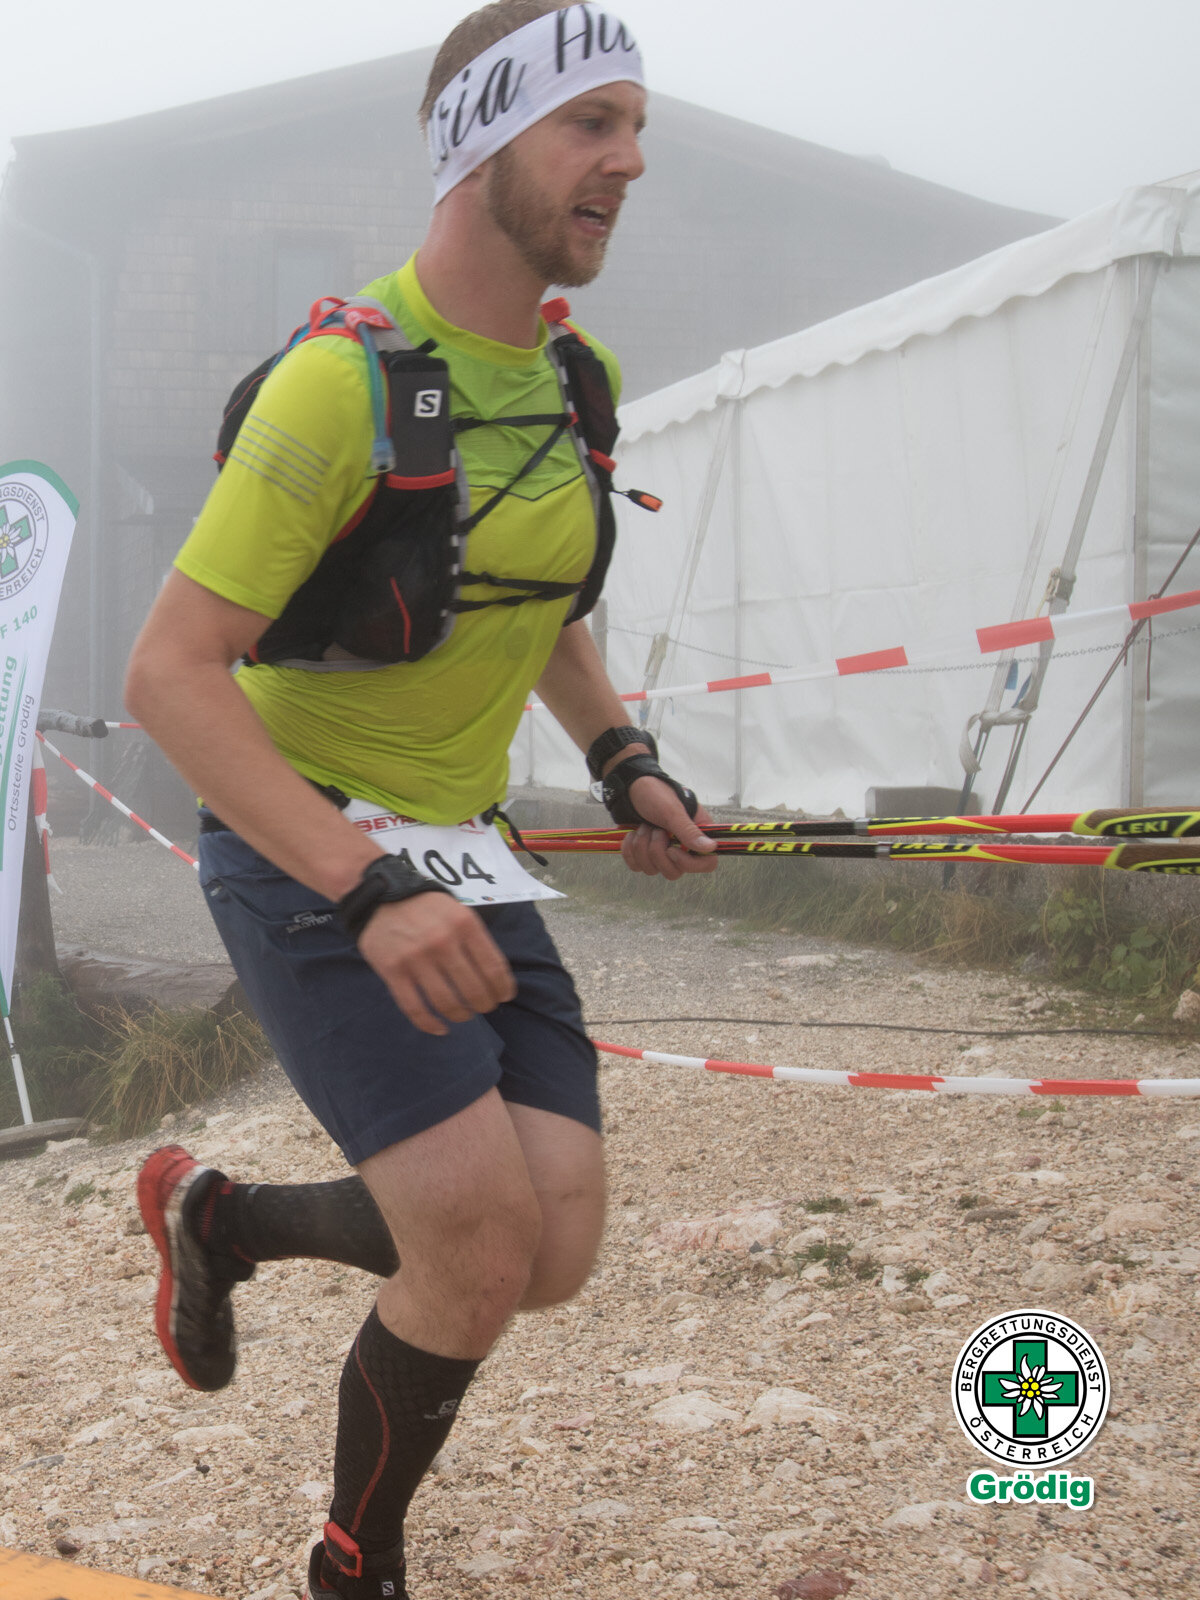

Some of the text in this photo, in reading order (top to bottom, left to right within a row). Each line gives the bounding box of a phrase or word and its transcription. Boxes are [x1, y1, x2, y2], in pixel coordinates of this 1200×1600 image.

[13, 605, 38, 632] 140
[8, 694, 35, 831] Ortsstelle Grödig
[1115, 820, 1169, 835] LEKI
